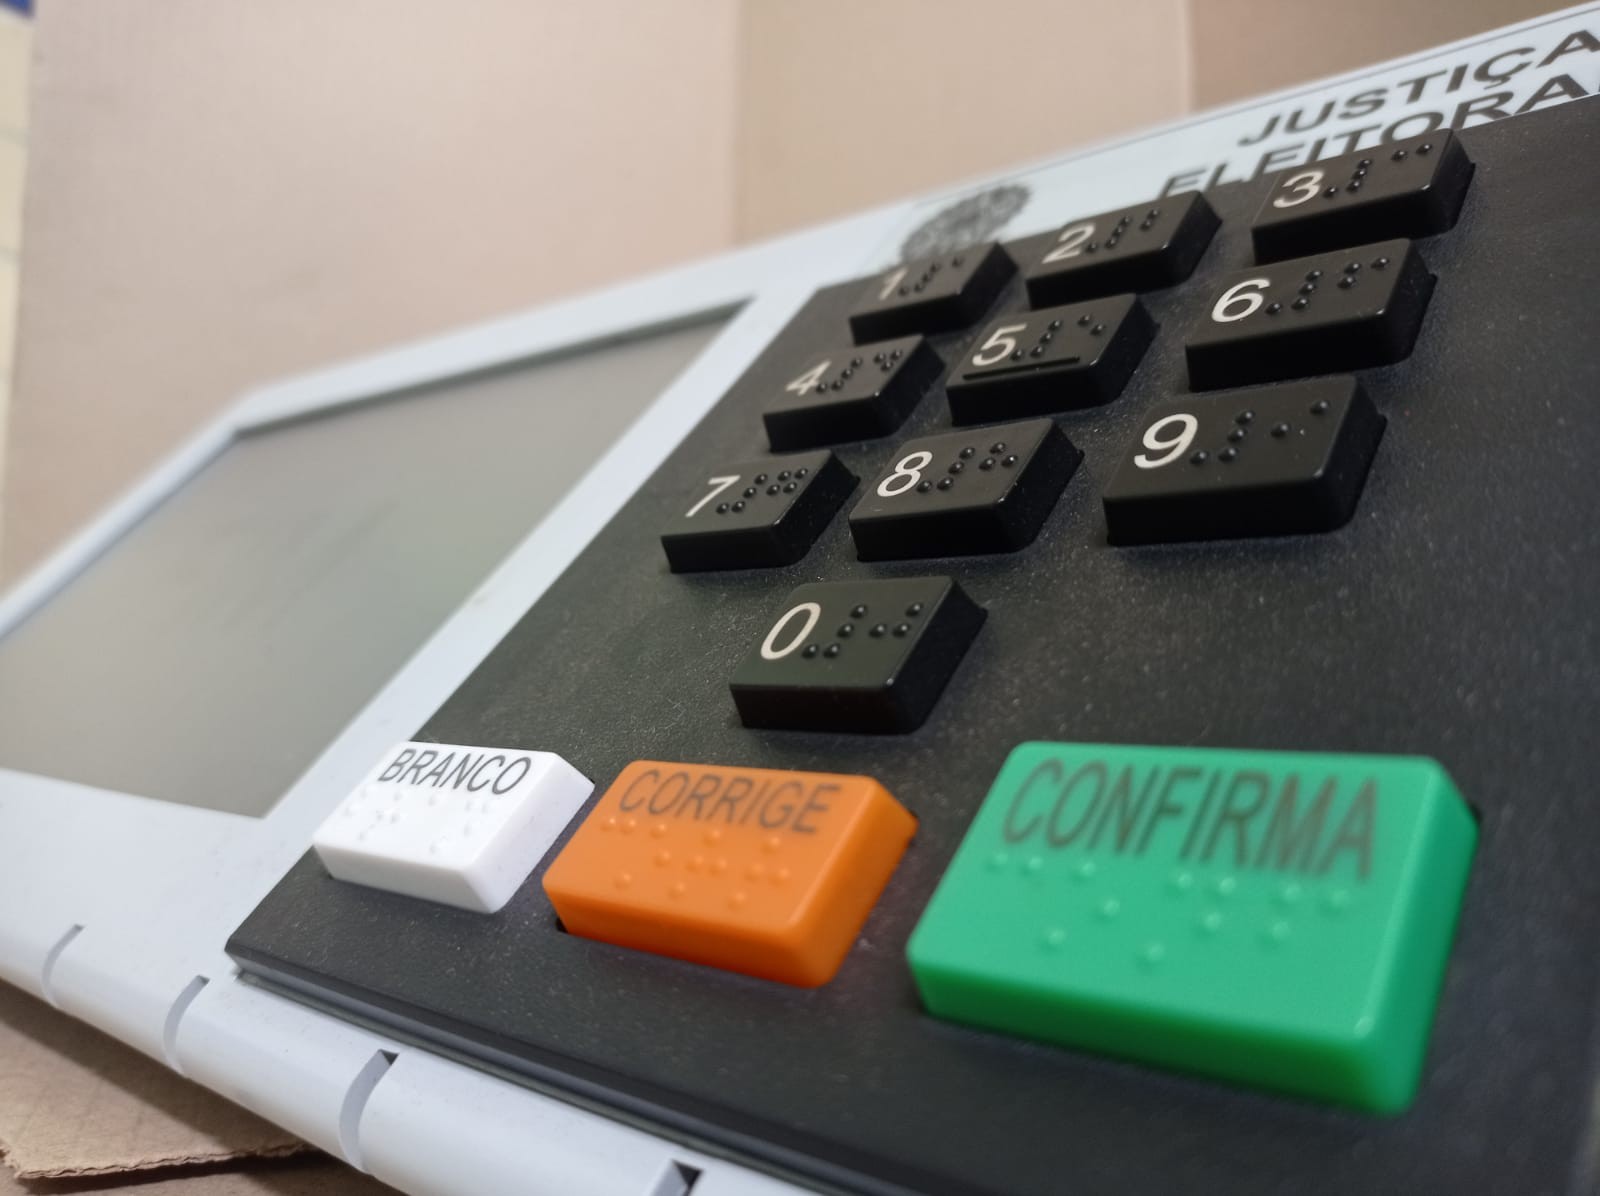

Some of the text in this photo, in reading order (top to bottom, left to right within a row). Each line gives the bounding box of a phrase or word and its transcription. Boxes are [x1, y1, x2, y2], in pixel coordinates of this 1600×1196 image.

[1237, 29, 1600, 148] JUSTIÇA
[1157, 73, 1600, 202] ELEITORA
[1272, 170, 1325, 209] 3
[1041, 222, 1096, 265] 2
[879, 269, 907, 301] 1
[1211, 278, 1271, 323] 6
[971, 323, 1027, 367] 5
[784, 360, 832, 396] 4
[1133, 413, 1198, 469] 9
[685, 474, 741, 518] 7
[876, 450, 933, 498] 8
[760, 602, 821, 660] 0
[377, 748, 533, 795] BRANCO
[619, 769, 842, 836] CORRIGE
[1003, 757, 1380, 883] CONFIRMA
